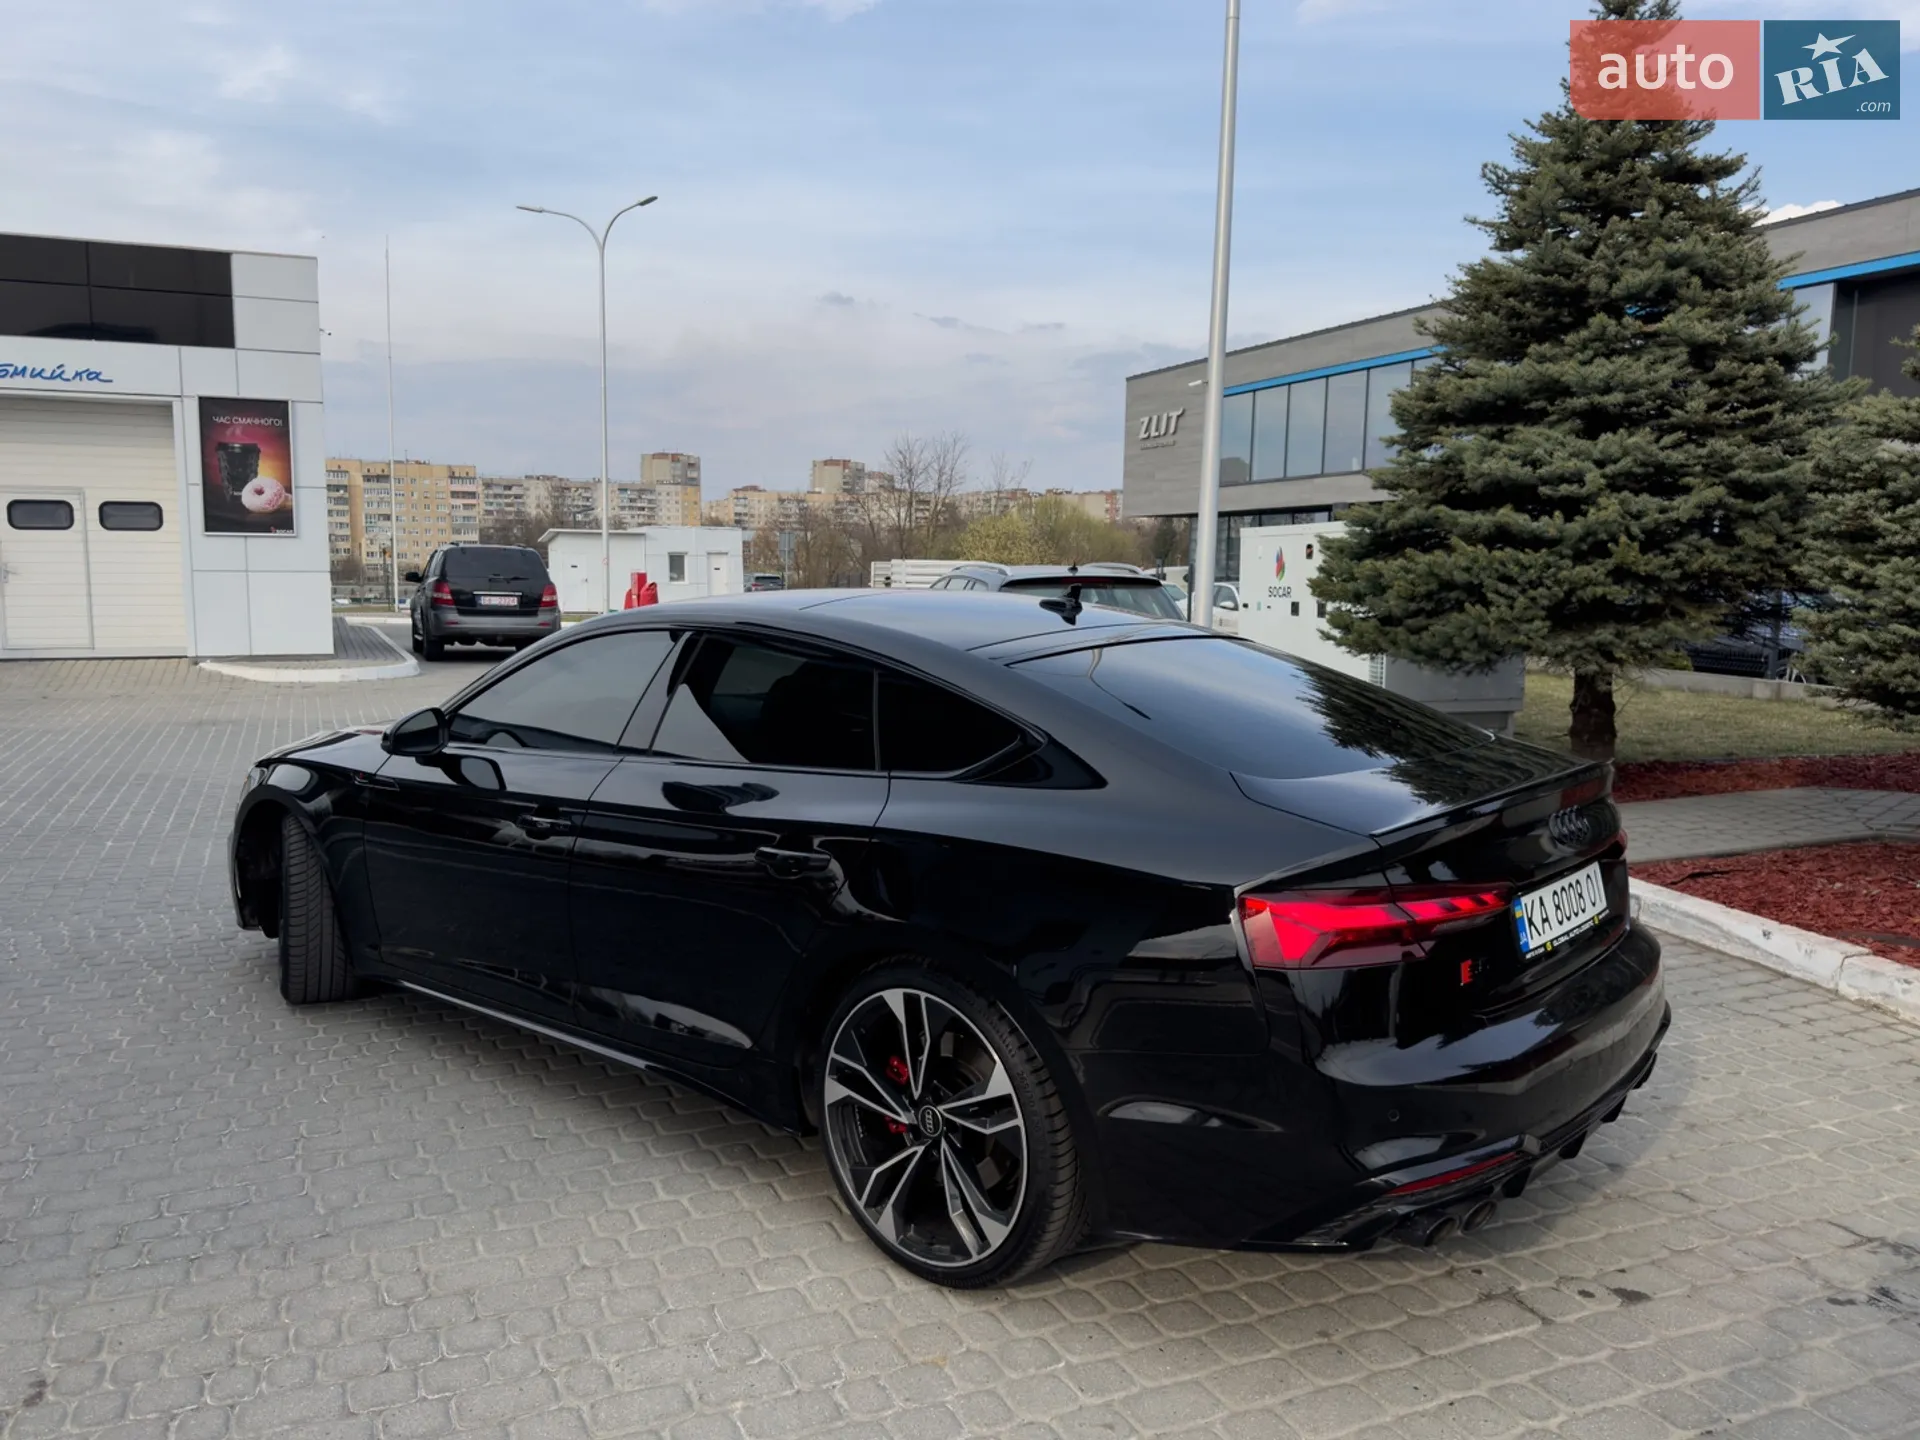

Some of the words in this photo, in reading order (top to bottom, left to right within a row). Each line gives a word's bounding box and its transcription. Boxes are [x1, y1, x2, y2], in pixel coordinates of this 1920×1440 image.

[212, 415, 231, 424] ЧАС
[1139, 407, 1185, 439] ZLIT
[1268, 586, 1292, 598] SOCAR
[1524, 896, 1553, 940] KA
[1552, 879, 1587, 926] 8008
